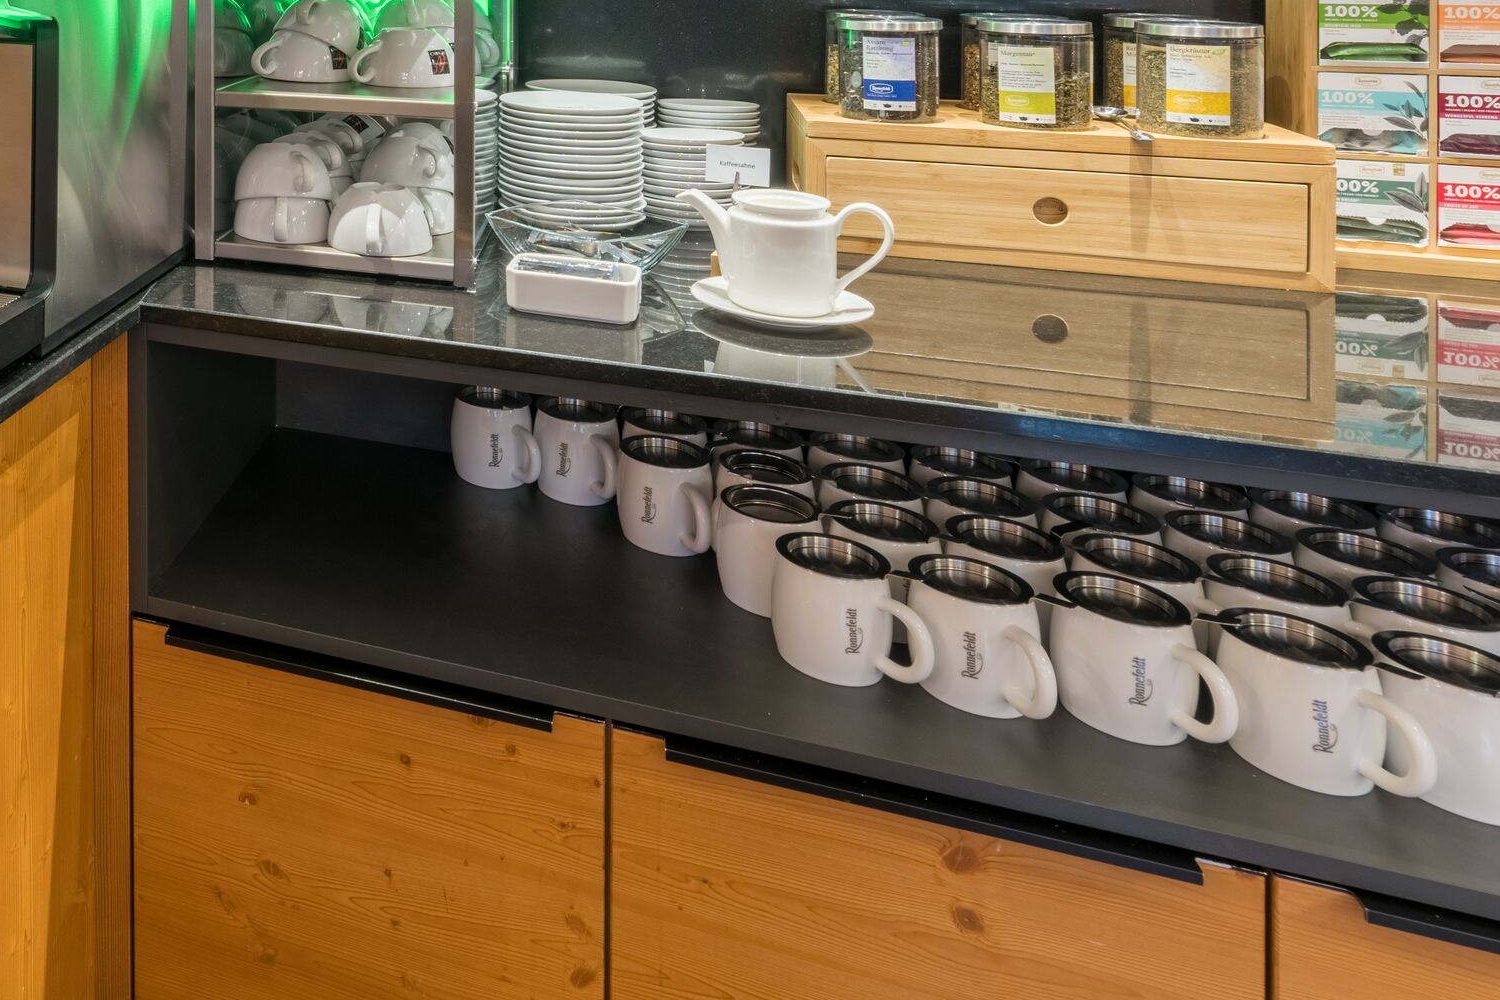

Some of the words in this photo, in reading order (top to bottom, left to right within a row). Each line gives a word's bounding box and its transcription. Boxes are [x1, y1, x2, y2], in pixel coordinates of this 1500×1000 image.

[1324, 5, 1378, 18] 100%
[1444, 6, 1500, 19] 100%
[1322, 91, 1375, 104] 100%
[1445, 95, 1500, 109] 100%
[719, 160, 756, 169] Kaffeesahne
[1336, 179, 1379, 193] 00%
[1443, 184, 1500, 199] 100%
[488, 433, 503, 468] Ronnefeldt
[556, 442, 571, 478] Ronnefeldt
[640, 486, 656, 525] Ronnefeldt
[845, 608, 863, 655] Ronnefeldt
[961, 631, 984, 680] Ronnefeldt
[1129, 656, 1153, 707] Ronnefeldt
[1312, 699, 1338, 754] Ronnefeldt
